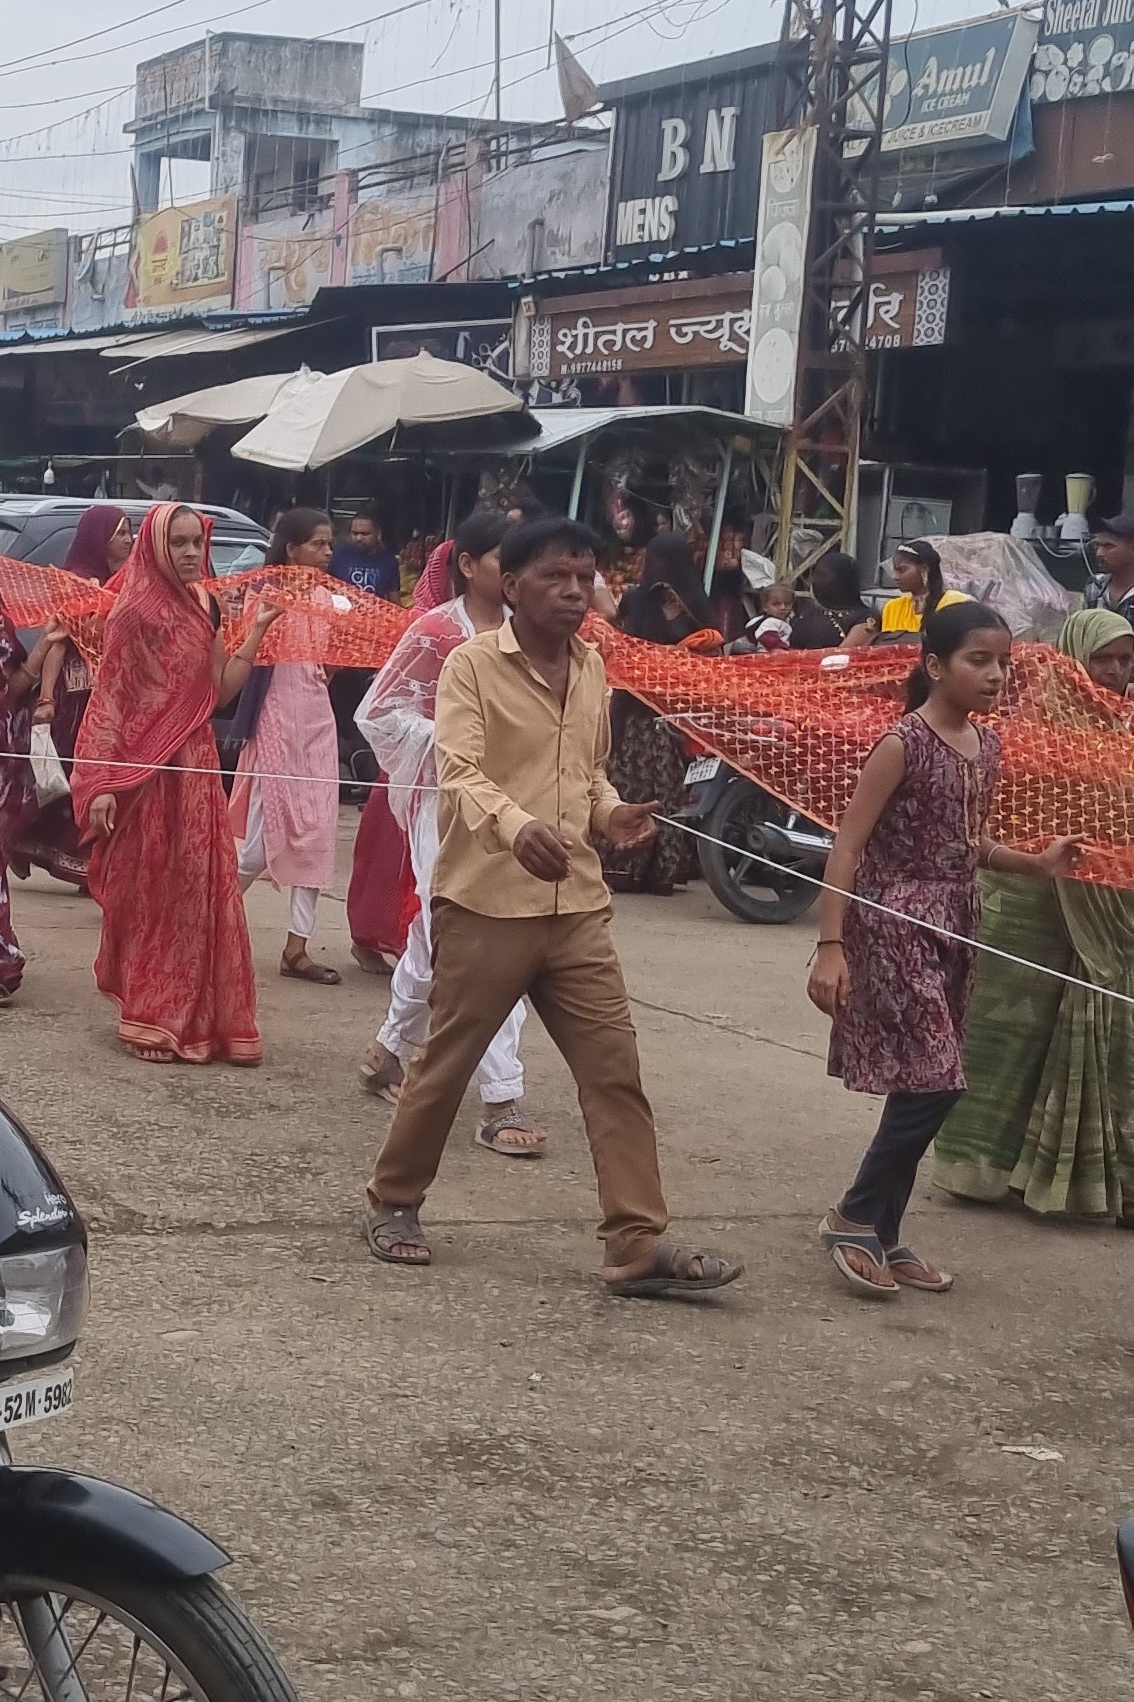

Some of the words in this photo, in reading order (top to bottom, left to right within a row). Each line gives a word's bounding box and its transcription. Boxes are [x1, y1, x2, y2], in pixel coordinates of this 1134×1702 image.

[1044, 0, 1100, 36] Sheetal
[912, 46, 997, 97] Amul
[921, 99, 936, 113] ICE
[937, 92, 971, 110] CREAM
[657, 117, 690, 182] B
[699, 106, 741, 174] N
[887, 127, 917, 143] JUICE
[917, 124, 926, 138] &
[616, 195, 679, 246] MENS
[556, 316, 658, 359] शीतल
